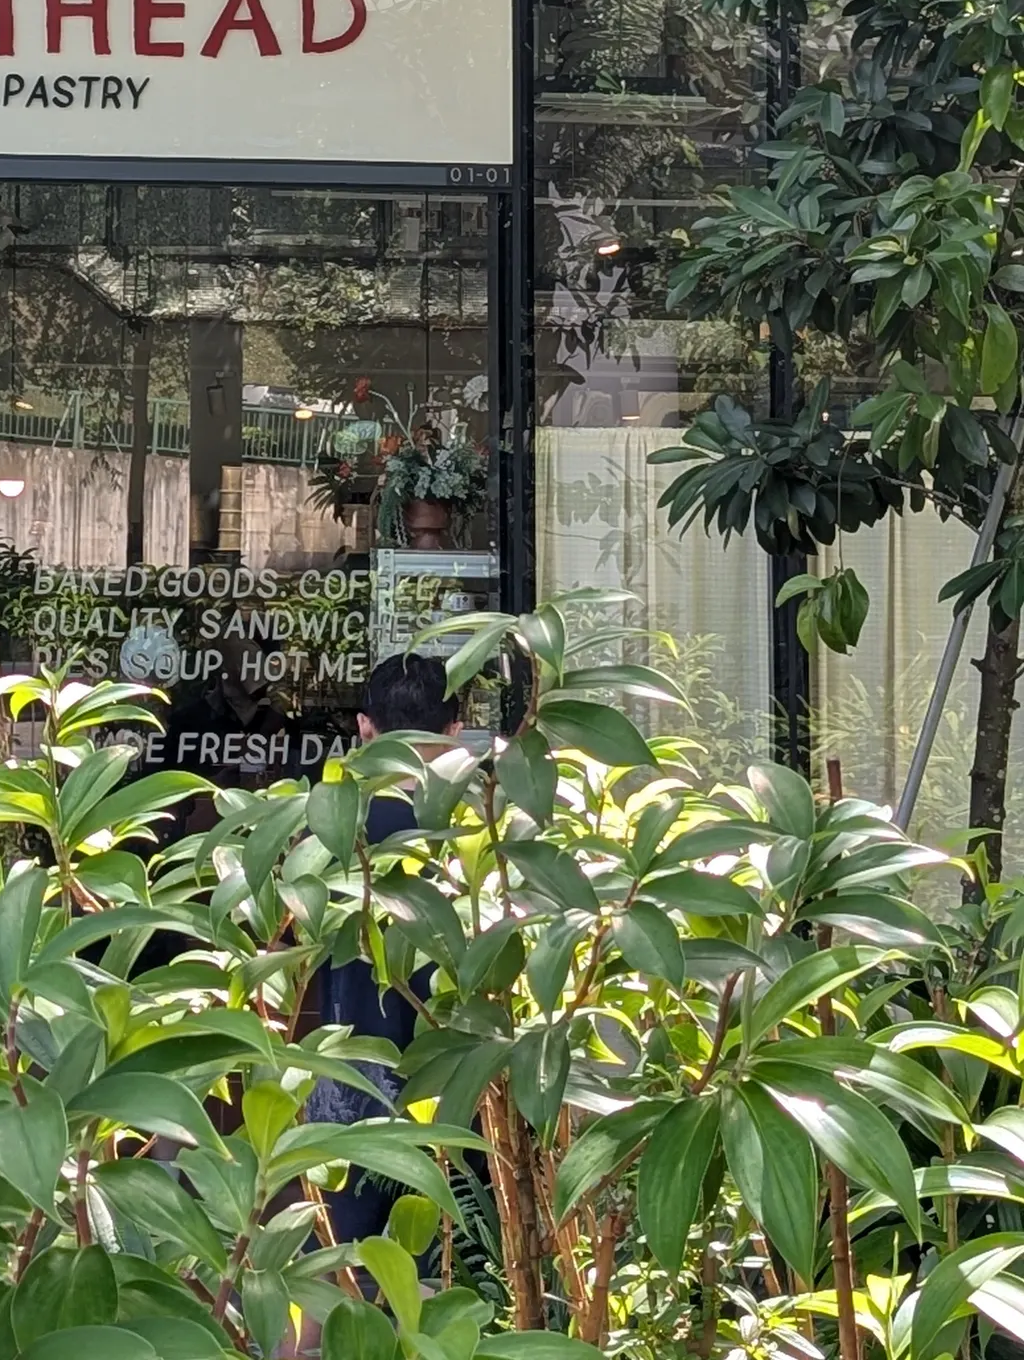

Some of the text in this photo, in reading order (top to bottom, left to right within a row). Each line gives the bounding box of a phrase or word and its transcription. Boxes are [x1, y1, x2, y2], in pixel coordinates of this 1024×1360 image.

[2, 73, 150, 110] PASTRY
[450, 166, 510, 184] 01-01
[33, 566, 148, 597] BAKED
[159, 566, 286, 599] GOODS.
[130, 648, 228, 681] SOUP.
[240, 650, 309, 682] HOT
[176, 732, 289, 765] FRESH
